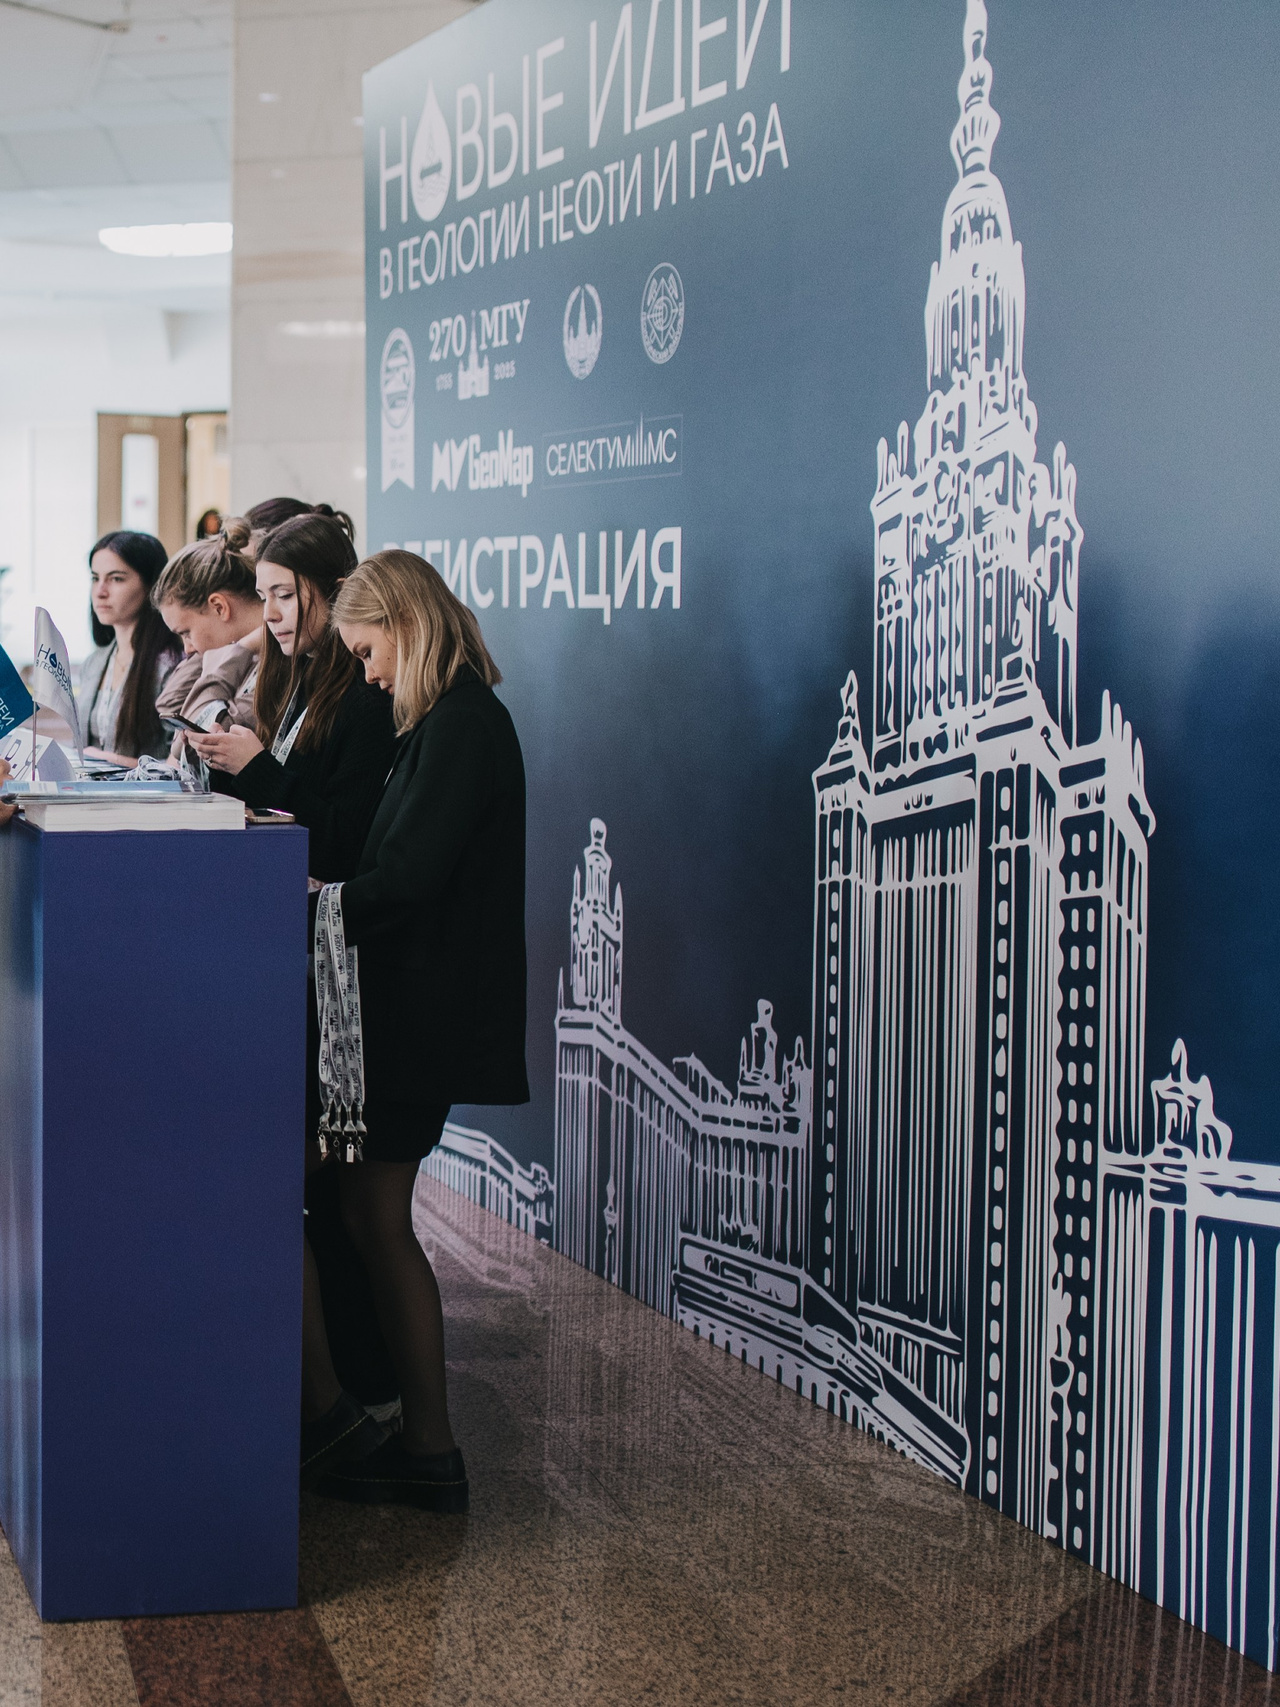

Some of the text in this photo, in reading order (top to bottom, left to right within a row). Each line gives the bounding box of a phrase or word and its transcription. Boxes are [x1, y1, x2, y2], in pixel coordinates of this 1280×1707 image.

[380, 37, 565, 231] НОВЫЕ
[379, 102, 789, 300] В ГЕОЛОГИИ НЕФТИ И ГАЗА
[428, 299, 531, 362] 270 МГУ
[468, 429, 534, 497] GeoMap
[382, 526, 682, 626] ИСТРАЦИЯ
